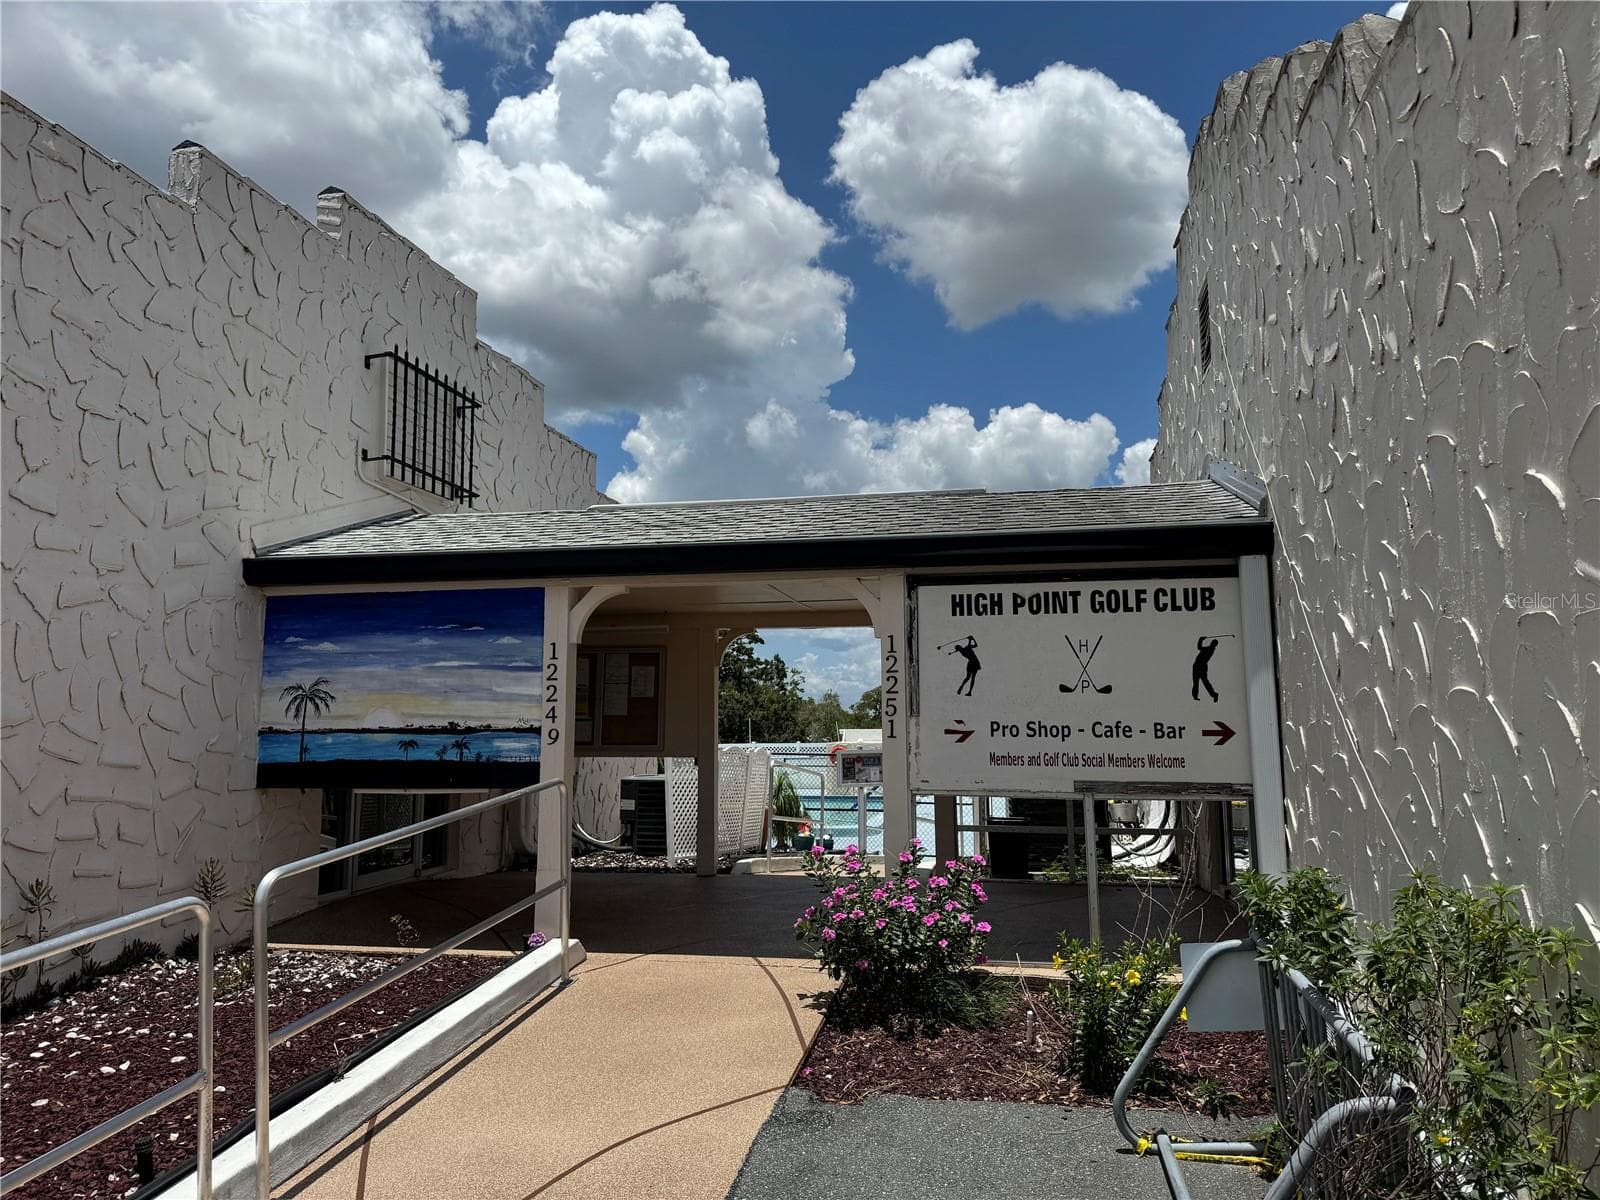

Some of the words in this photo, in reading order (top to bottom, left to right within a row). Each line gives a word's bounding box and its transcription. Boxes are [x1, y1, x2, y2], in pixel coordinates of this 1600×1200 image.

[951, 593, 1003, 617] HIGH
[1012, 591, 1081, 615] POINT
[1090, 589, 1147, 613] GOLF
[1153, 587, 1216, 612] CLUB
[1079, 640, 1089, 653] H
[545, 642, 560, 745] 12249
[885, 635, 899, 738] 12251
[1081, 680, 1090, 694] P
[990, 721, 1020, 738] Pro
[1026, 721, 1072, 742] Shop
[1091, 721, 1133, 739] Cafe
[1153, 723, 1186, 739] Bar
[989, 752, 1025, 767] Members
[1027, 752, 1041, 767] and
[1043, 752, 1059, 768] Golf
[1061, 752, 1079, 767] Club
[1081, 753, 1106, 768] Social
[1107, 753, 1145, 768] Members
[1147, 754, 1186, 769] Welcome
